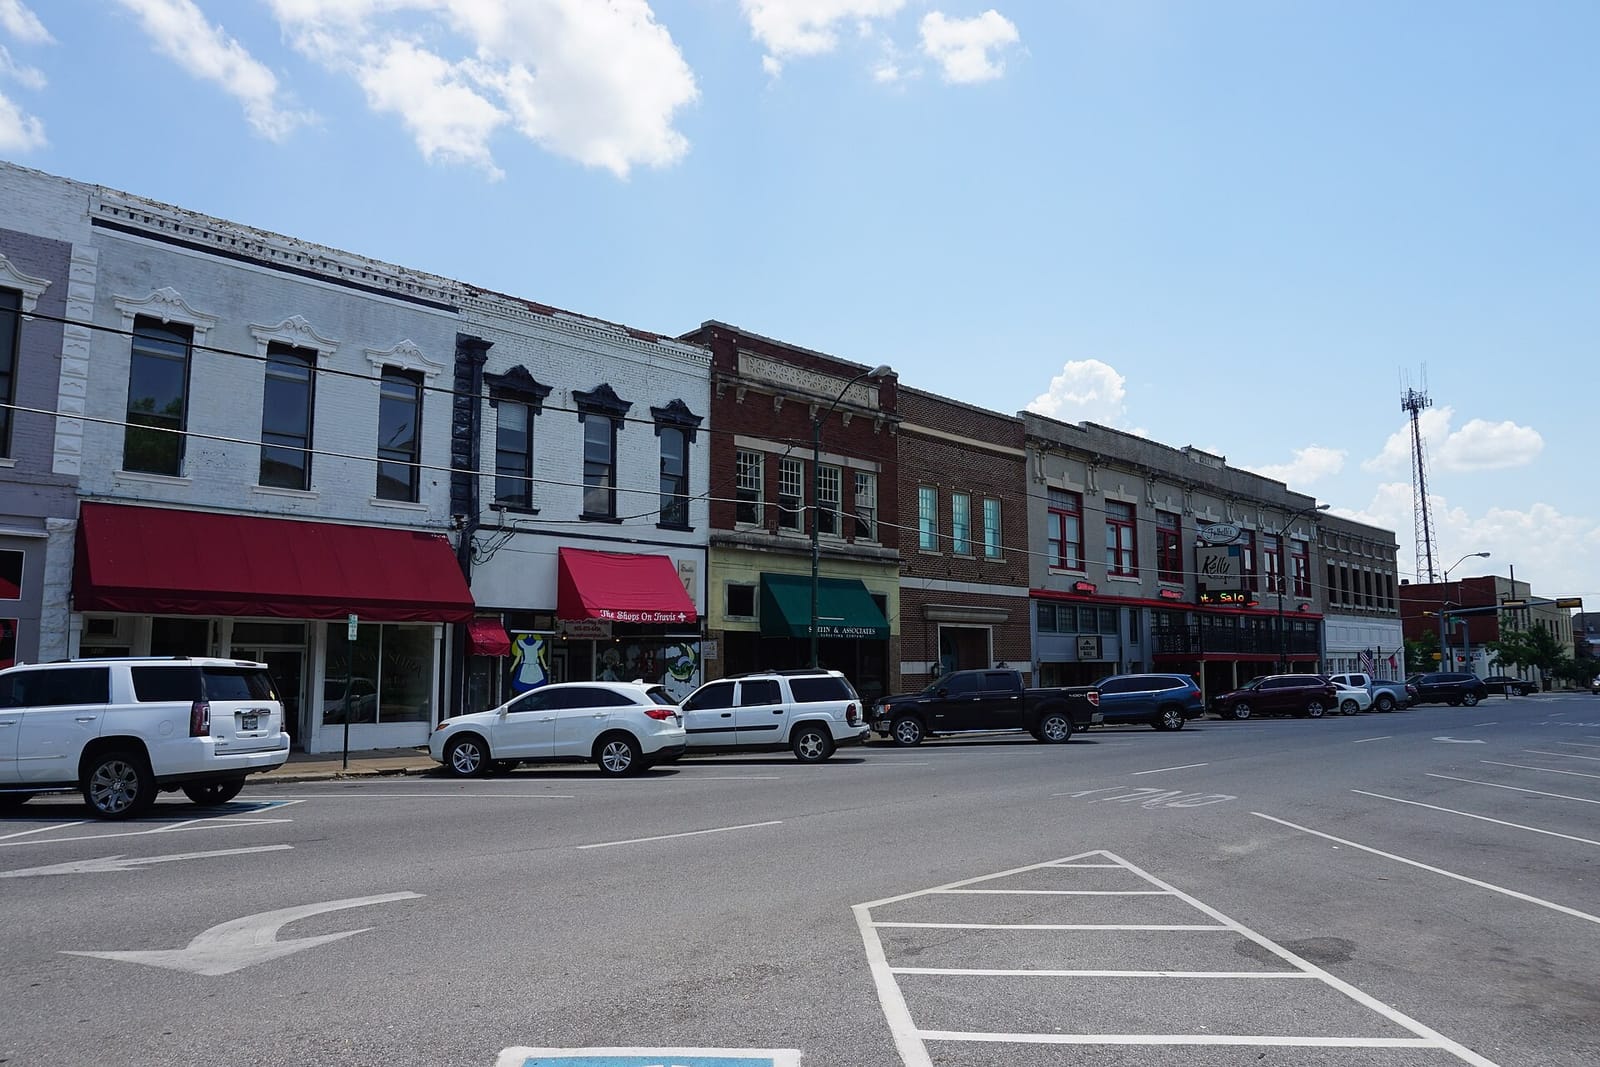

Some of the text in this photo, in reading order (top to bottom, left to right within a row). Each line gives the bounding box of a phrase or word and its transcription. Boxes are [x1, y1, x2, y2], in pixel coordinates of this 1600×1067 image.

[1202, 555, 1230, 577] Kelly
[685, 577, 691, 590] 7
[599, 610, 676, 622] The Shops On Travis
[842, 627, 876, 635] ASSOCIATES
